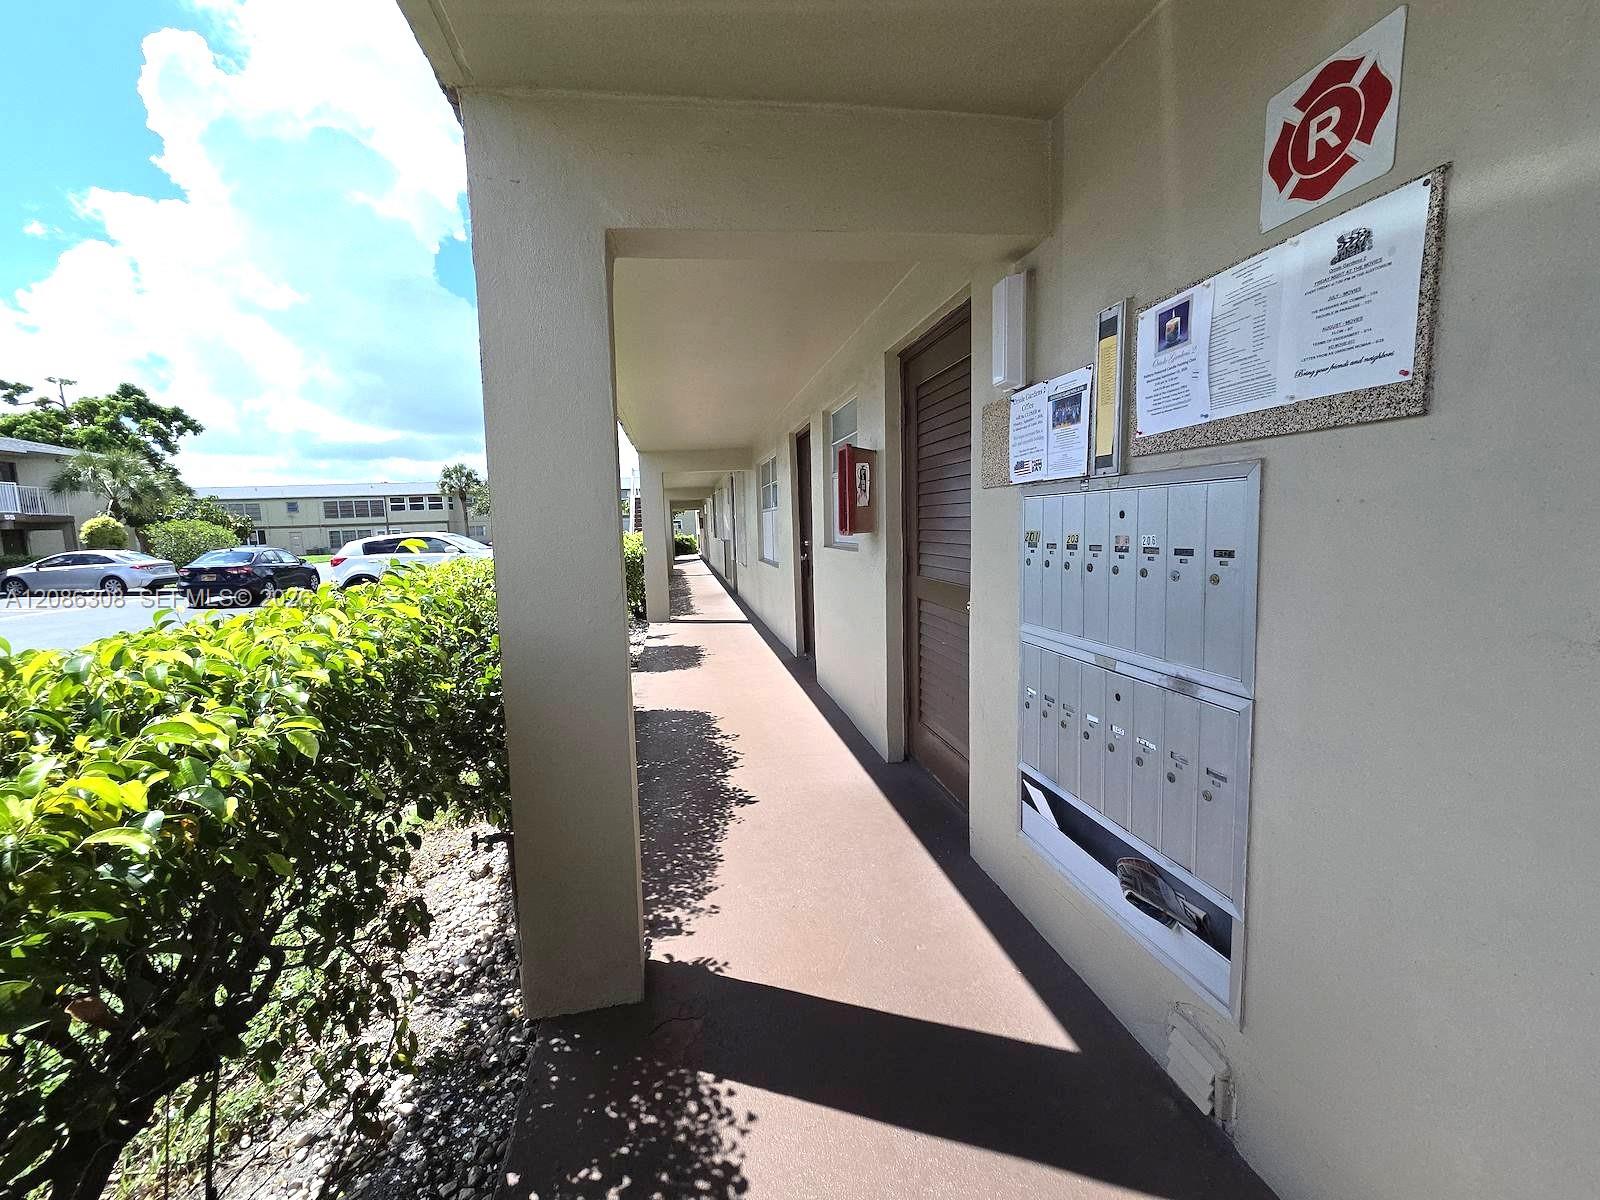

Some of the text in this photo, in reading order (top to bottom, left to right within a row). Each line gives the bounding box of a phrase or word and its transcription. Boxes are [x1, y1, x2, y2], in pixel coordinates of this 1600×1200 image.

[1307, 106, 1342, 162] R
[1294, 367, 1314, 378] Bring
[1313, 367, 1329, 377] your
[1349, 356, 1364, 366] and
[1066, 534, 1079, 544] 203
